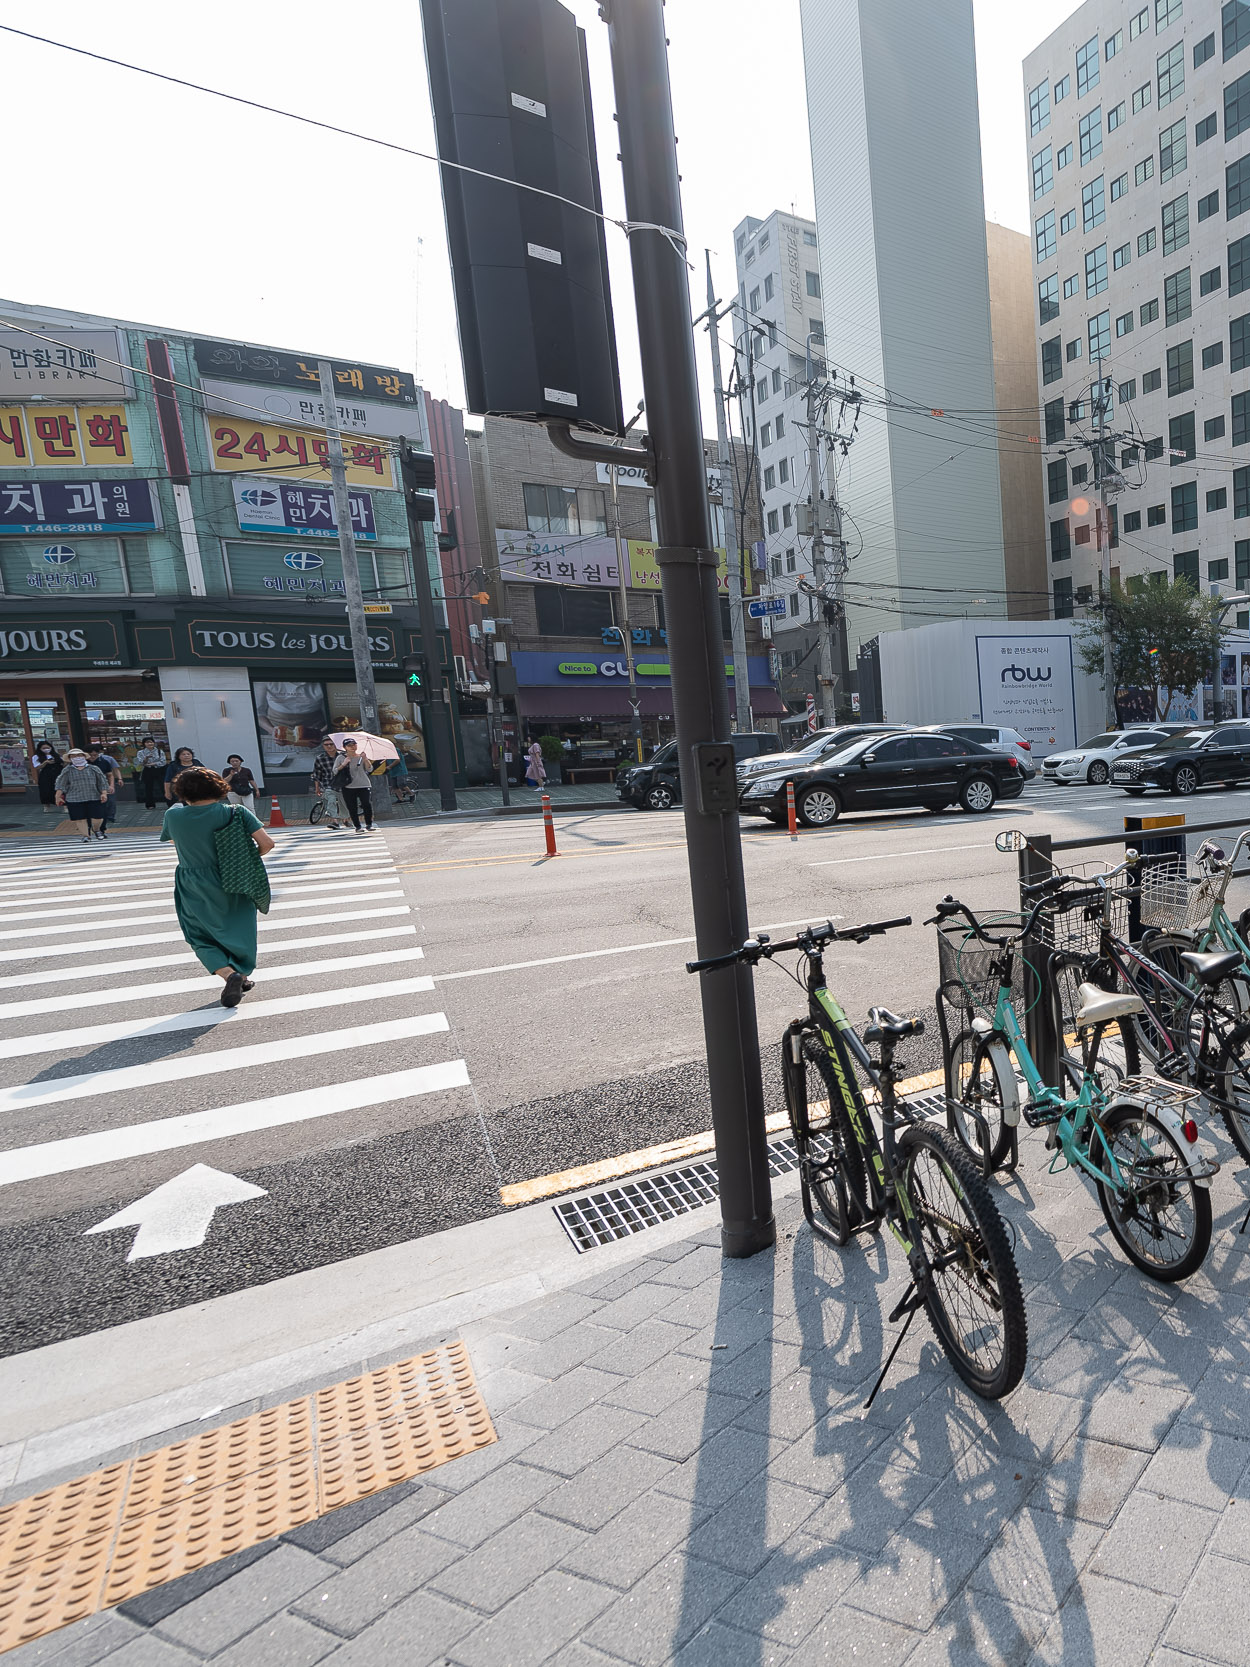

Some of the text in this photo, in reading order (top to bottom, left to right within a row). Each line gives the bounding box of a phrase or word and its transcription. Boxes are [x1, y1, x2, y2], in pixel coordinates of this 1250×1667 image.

[10, 349, 97, 369] 만화카페
[14, 371, 97, 380] LIBRARY
[296, 361, 406, 396] 노래방
[22, 523, 103, 533] T.446-2818
[196, 630, 276, 649] TOUS
[281, 632, 306, 649] les
[600, 661, 630, 676] CU
[1001, 664, 1051, 682] rbw
